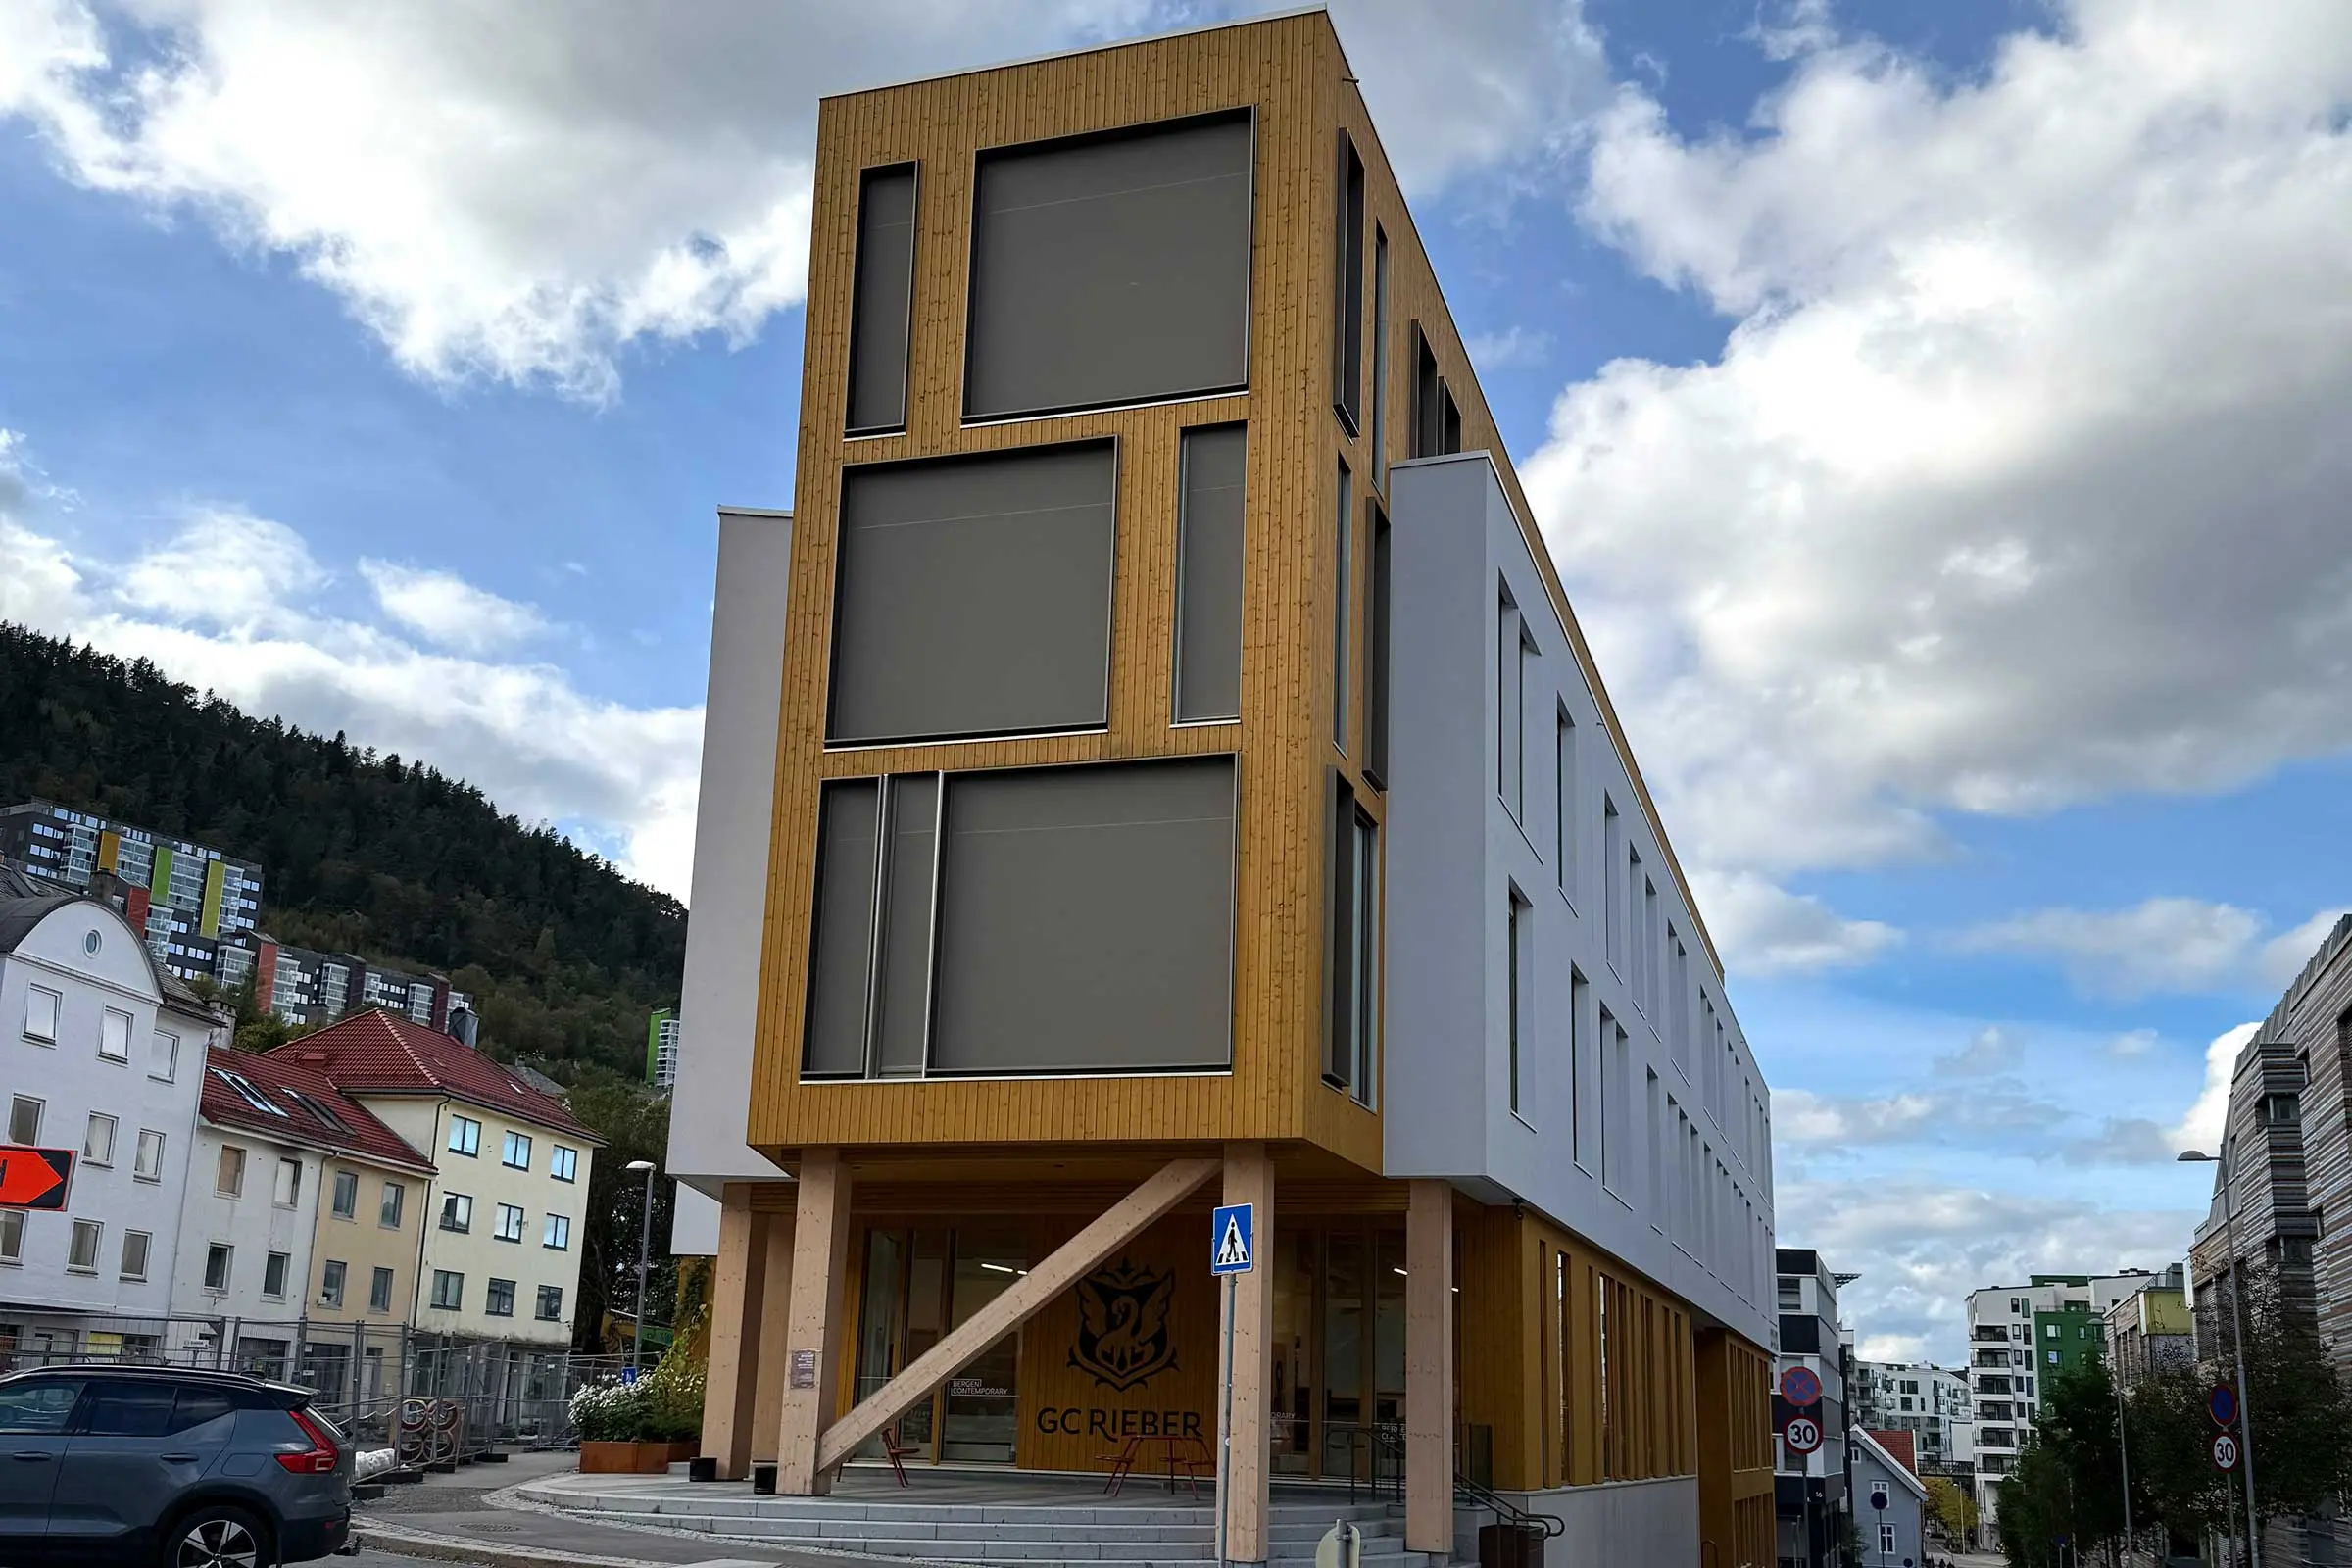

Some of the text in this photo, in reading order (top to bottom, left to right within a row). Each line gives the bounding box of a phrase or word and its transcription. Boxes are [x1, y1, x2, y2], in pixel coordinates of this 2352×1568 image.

[1036, 1407, 1203, 1443] GC RIEBER
[1790, 1424, 1816, 1444] 30
[2216, 1442, 2234, 1462] 30
